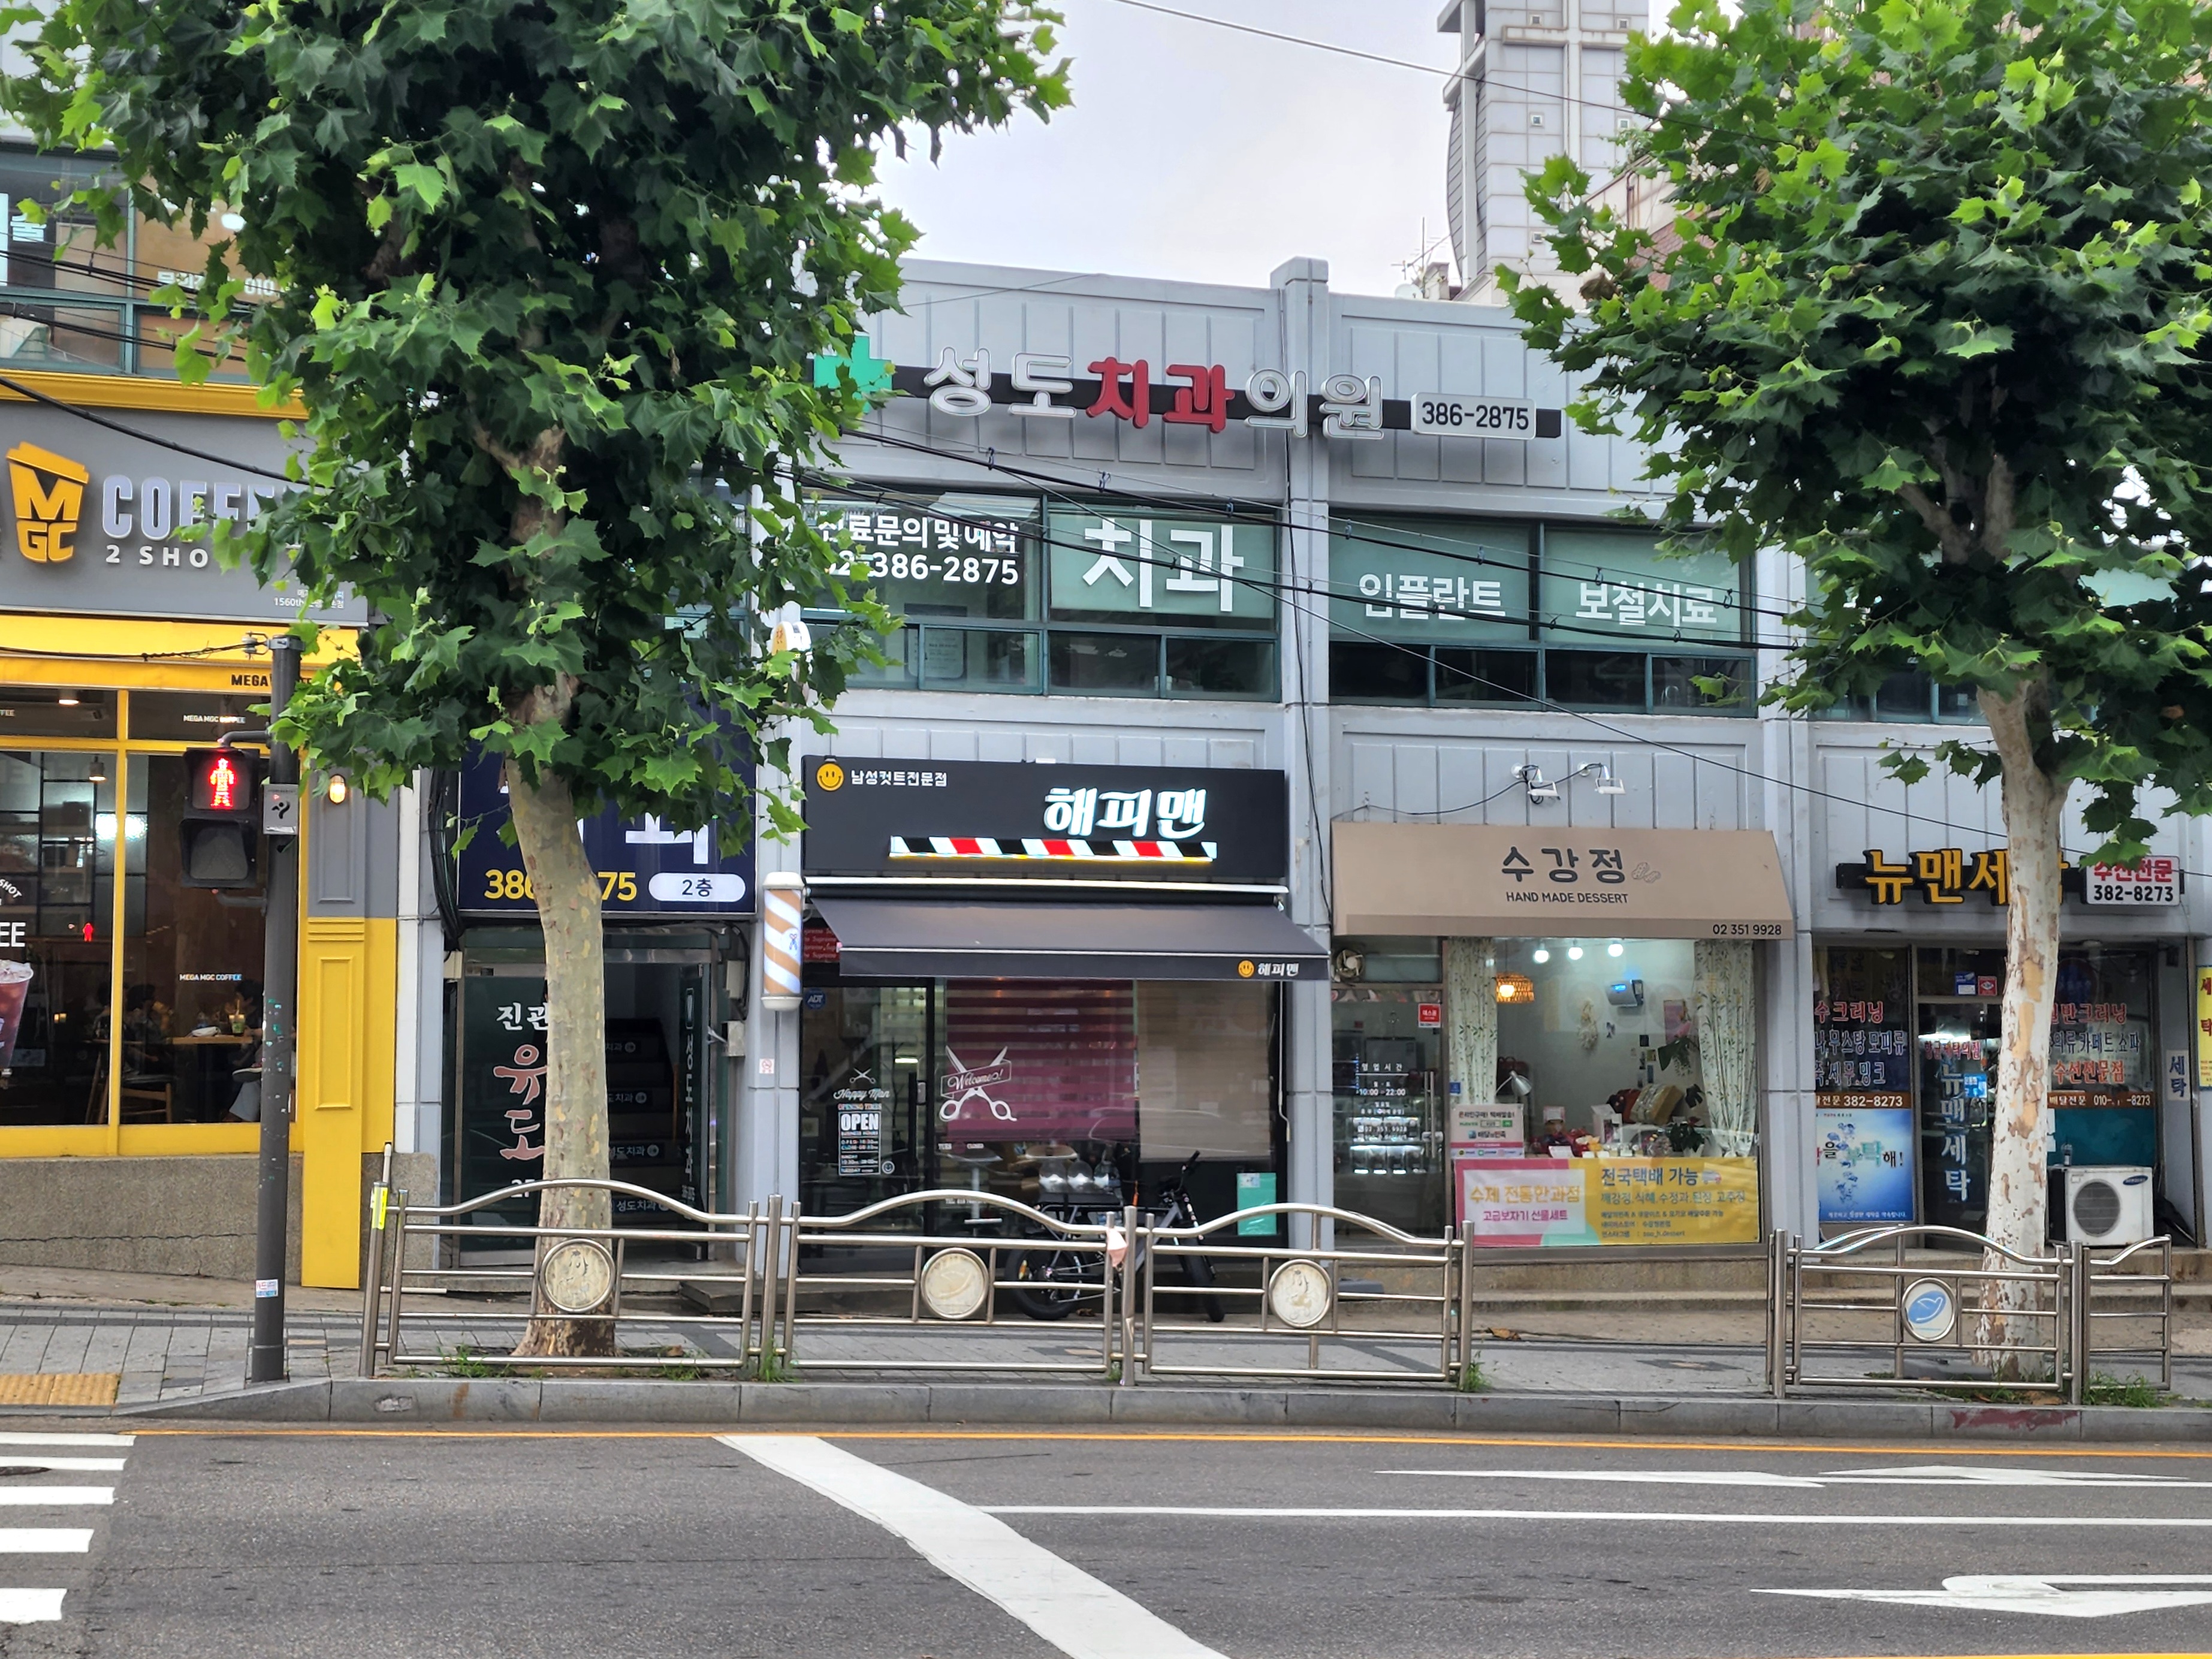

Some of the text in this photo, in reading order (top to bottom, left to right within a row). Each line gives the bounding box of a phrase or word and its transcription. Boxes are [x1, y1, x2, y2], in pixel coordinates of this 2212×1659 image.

[923, 346, 1384, 441] 성도치과의원
[1422, 400, 1530, 431] 386-2875
[102, 475, 302, 550] COFF
[139, 546, 210, 568] SHO
[1082, 518, 1244, 612] 치과
[1359, 573, 1507, 620] 임플란트
[1575, 580, 1718, 627] 보철치료
[231, 674, 268, 687] MEGA
[1044, 788, 1206, 839] 해피맨
[1501, 846, 1626, 884] 수강정
[1865, 849, 2069, 904] 뉴맨세
[681, 879, 713, 898] 2층
[1505, 891, 1628, 904] HAND MADE DESSERT
[2093, 885, 2174, 902] 382-8273
[1712, 924, 1782, 936] 02 351 9928
[1258, 963, 1299, 977] 해피맨
[2053, 1060, 2125, 1084] 수선전문점
[2168, 1055, 2187, 1097] 세탁
[832, 1088, 868, 1101] Happy
[1843, 1096, 1903, 1107] 382-8273
[840, 1113, 879, 1131] OPEN
[1601, 1167, 1698, 1186] 전국택배 가능
[1469, 1185, 1580, 1203] 수제 전통한과점
[616, 1199, 657, 1212] 성도치과
[1483, 1209, 1568, 1221] 고급보자기 선물세트
